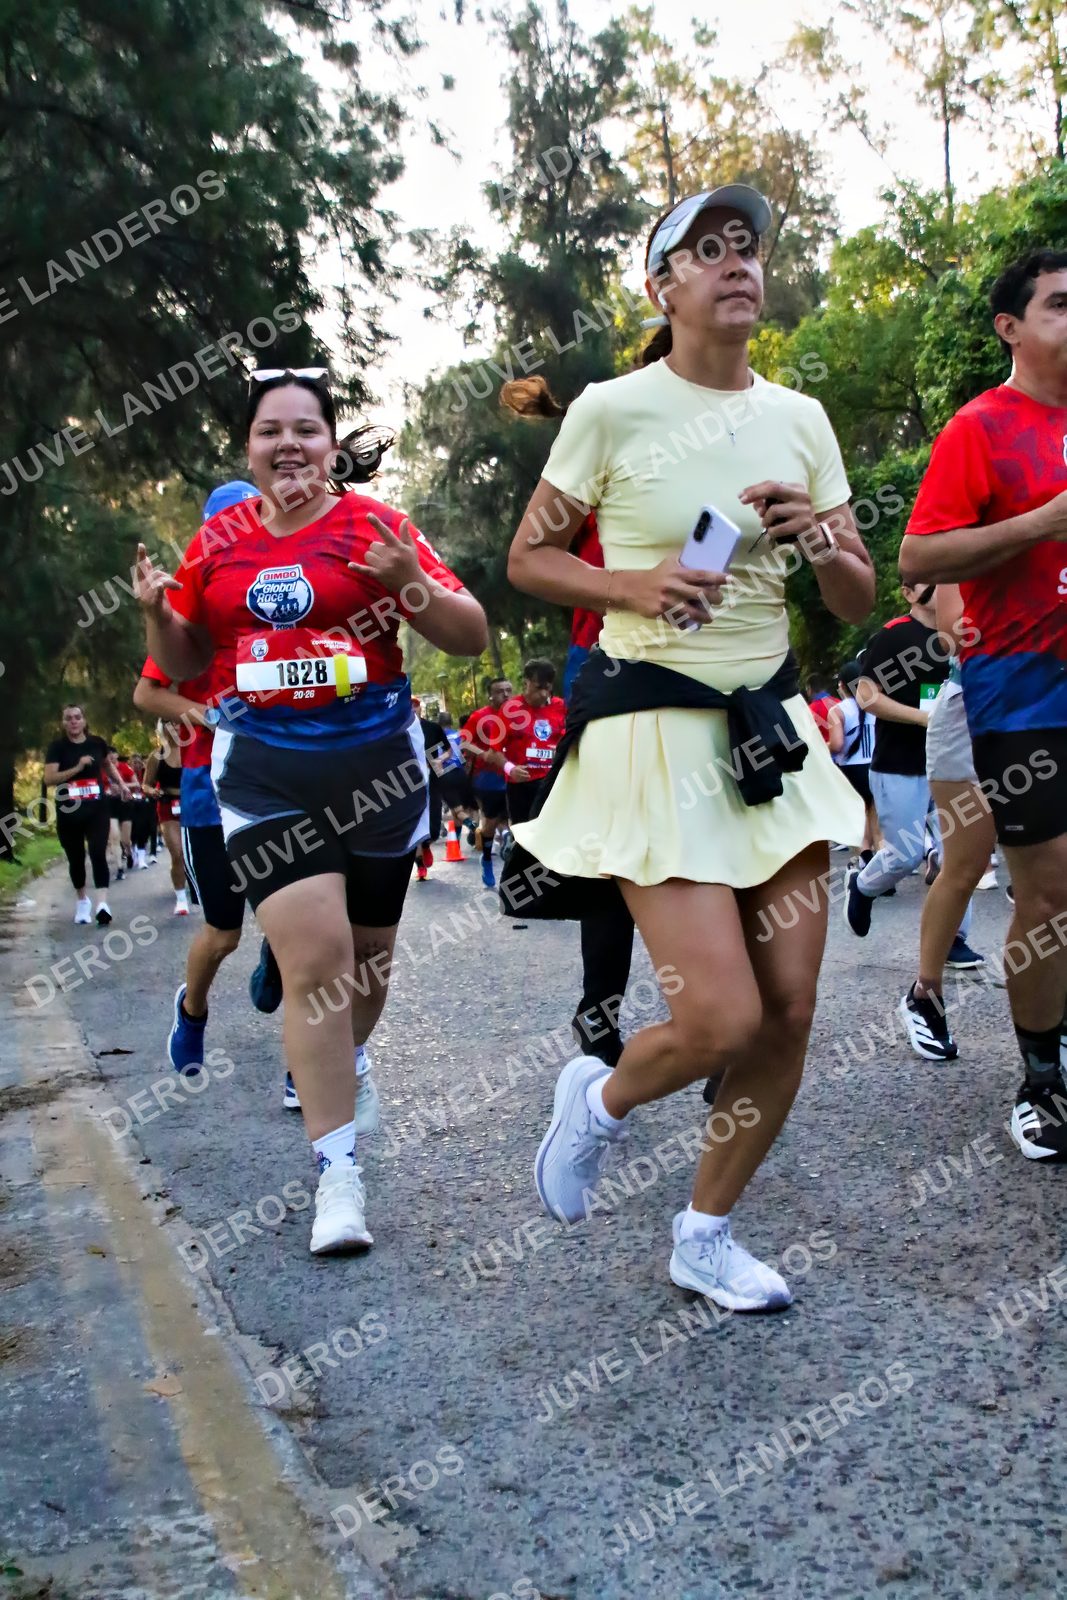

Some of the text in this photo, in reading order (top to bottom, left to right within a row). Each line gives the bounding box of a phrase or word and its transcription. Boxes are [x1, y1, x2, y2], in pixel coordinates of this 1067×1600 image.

[263, 571, 297, 581] BIMBO
[262, 582, 297, 594] Global
[256, 592, 284, 604] Race
[276, 660, 328, 687] 1828
